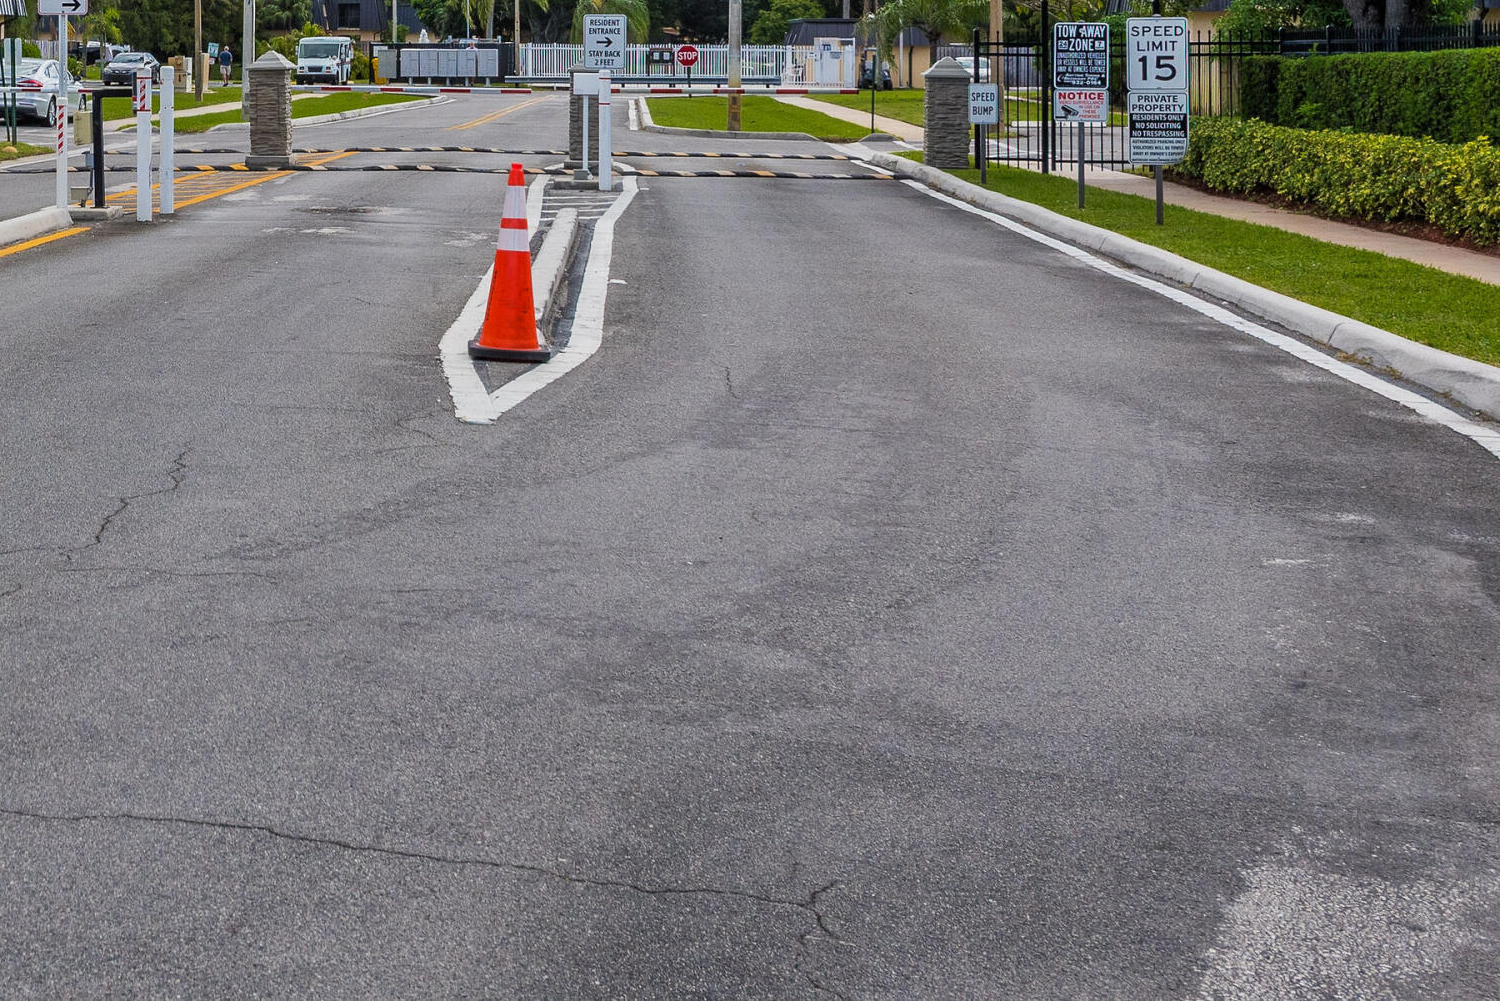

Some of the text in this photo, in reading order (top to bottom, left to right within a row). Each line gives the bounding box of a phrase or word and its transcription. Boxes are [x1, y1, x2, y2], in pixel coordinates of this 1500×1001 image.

[1057, 25, 1106, 38] TOW AWAY
[1130, 25, 1184, 37] SPEED
[1068, 38, 1094, 51] ZONE
[1136, 40, 1178, 52] LIMIT
[678, 51, 697, 61] STOP
[1138, 55, 1177, 81] 15
[971, 92, 995, 102] SPEED
[1058, 92, 1104, 100] NOTICE
[1137, 95, 1178, 103] PRIVATE
[972, 105, 994, 115] BUMP
[1131, 104, 1184, 112] PROPERTY
